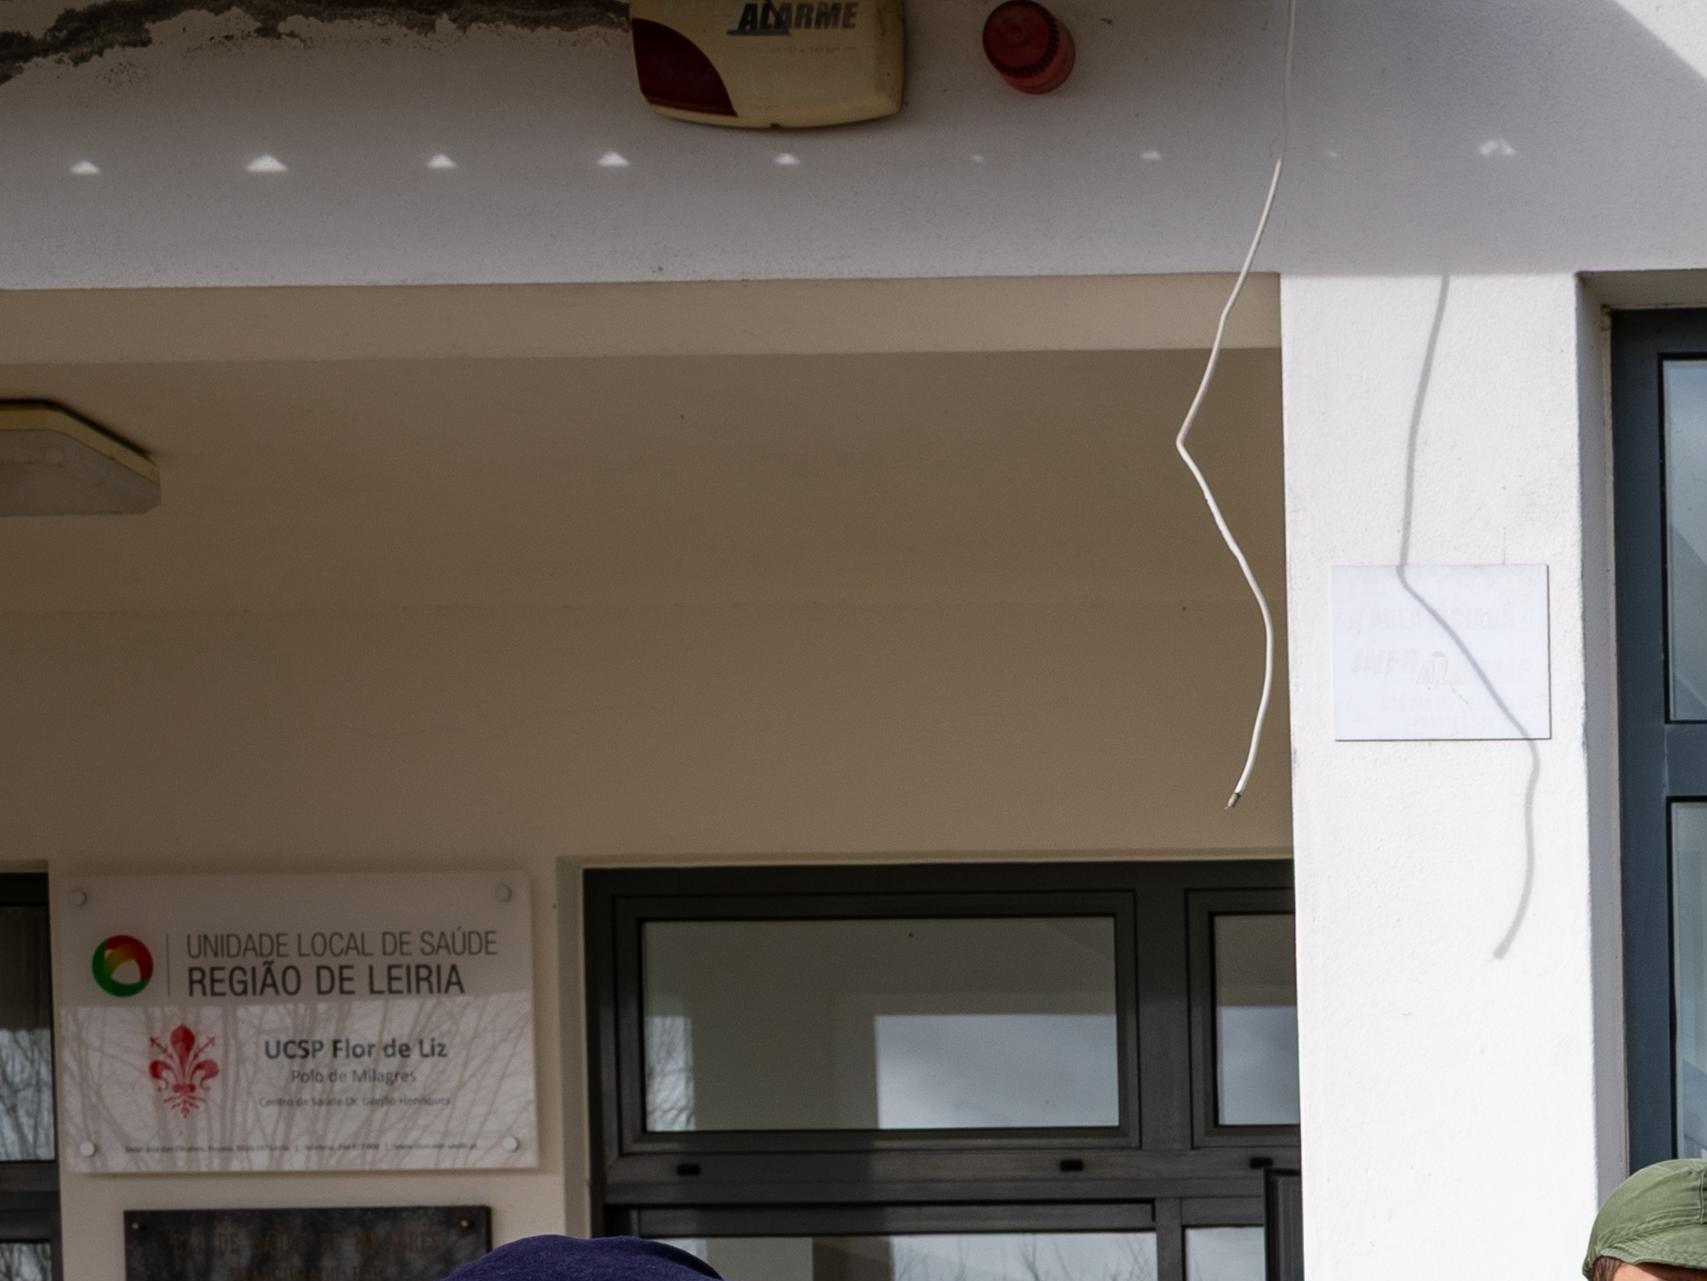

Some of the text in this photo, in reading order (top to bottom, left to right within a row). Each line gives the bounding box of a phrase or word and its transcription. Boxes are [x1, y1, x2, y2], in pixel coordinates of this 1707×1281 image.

[735, 1, 859, 32] ALARME
[186, 926, 498, 958] UNIDADE LOCAL DE SAÚDE
[187, 960, 465, 997] REGIÃO DE LEIRIA
[264, 1037, 448, 1060] UCSP Flor de Liz
[291, 1069, 416, 1086] Polo de Milagres
